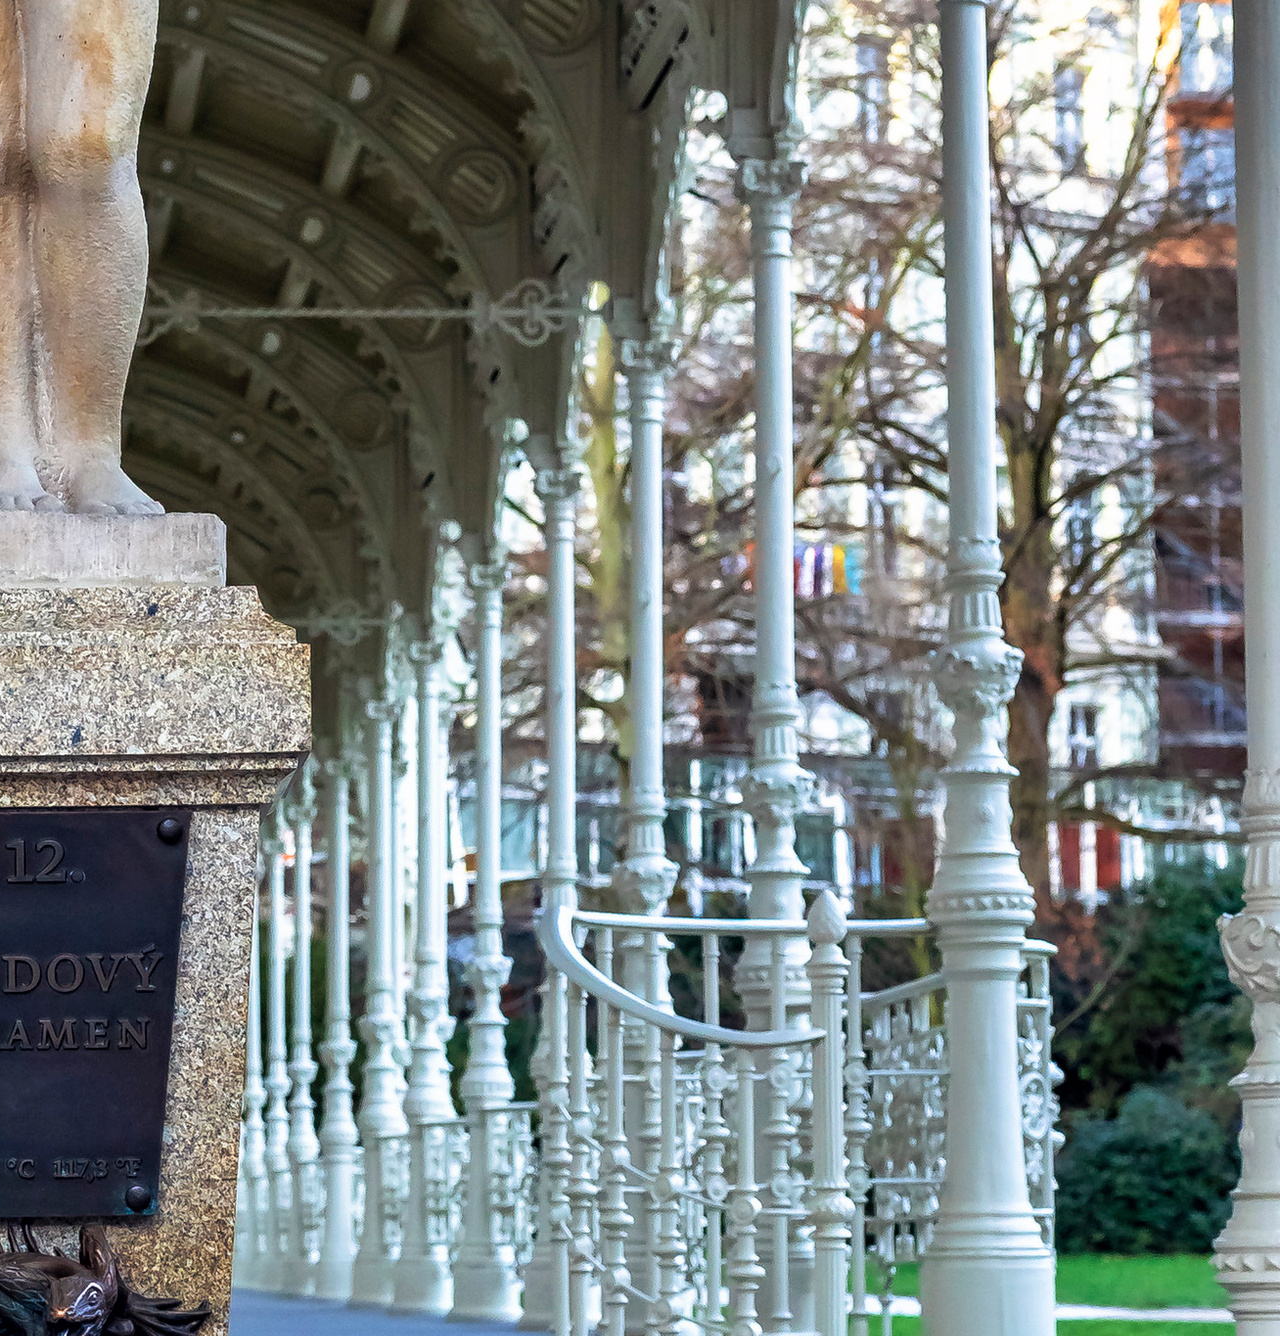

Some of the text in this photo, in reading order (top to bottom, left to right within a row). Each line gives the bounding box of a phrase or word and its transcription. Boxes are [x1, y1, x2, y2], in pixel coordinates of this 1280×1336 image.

[5, 838, 86, 883] 12.
[7, 1158, 35, 1179] °C
[53, 1159, 108, 1183] 117,3
[115, 1159, 143, 1177] °F
